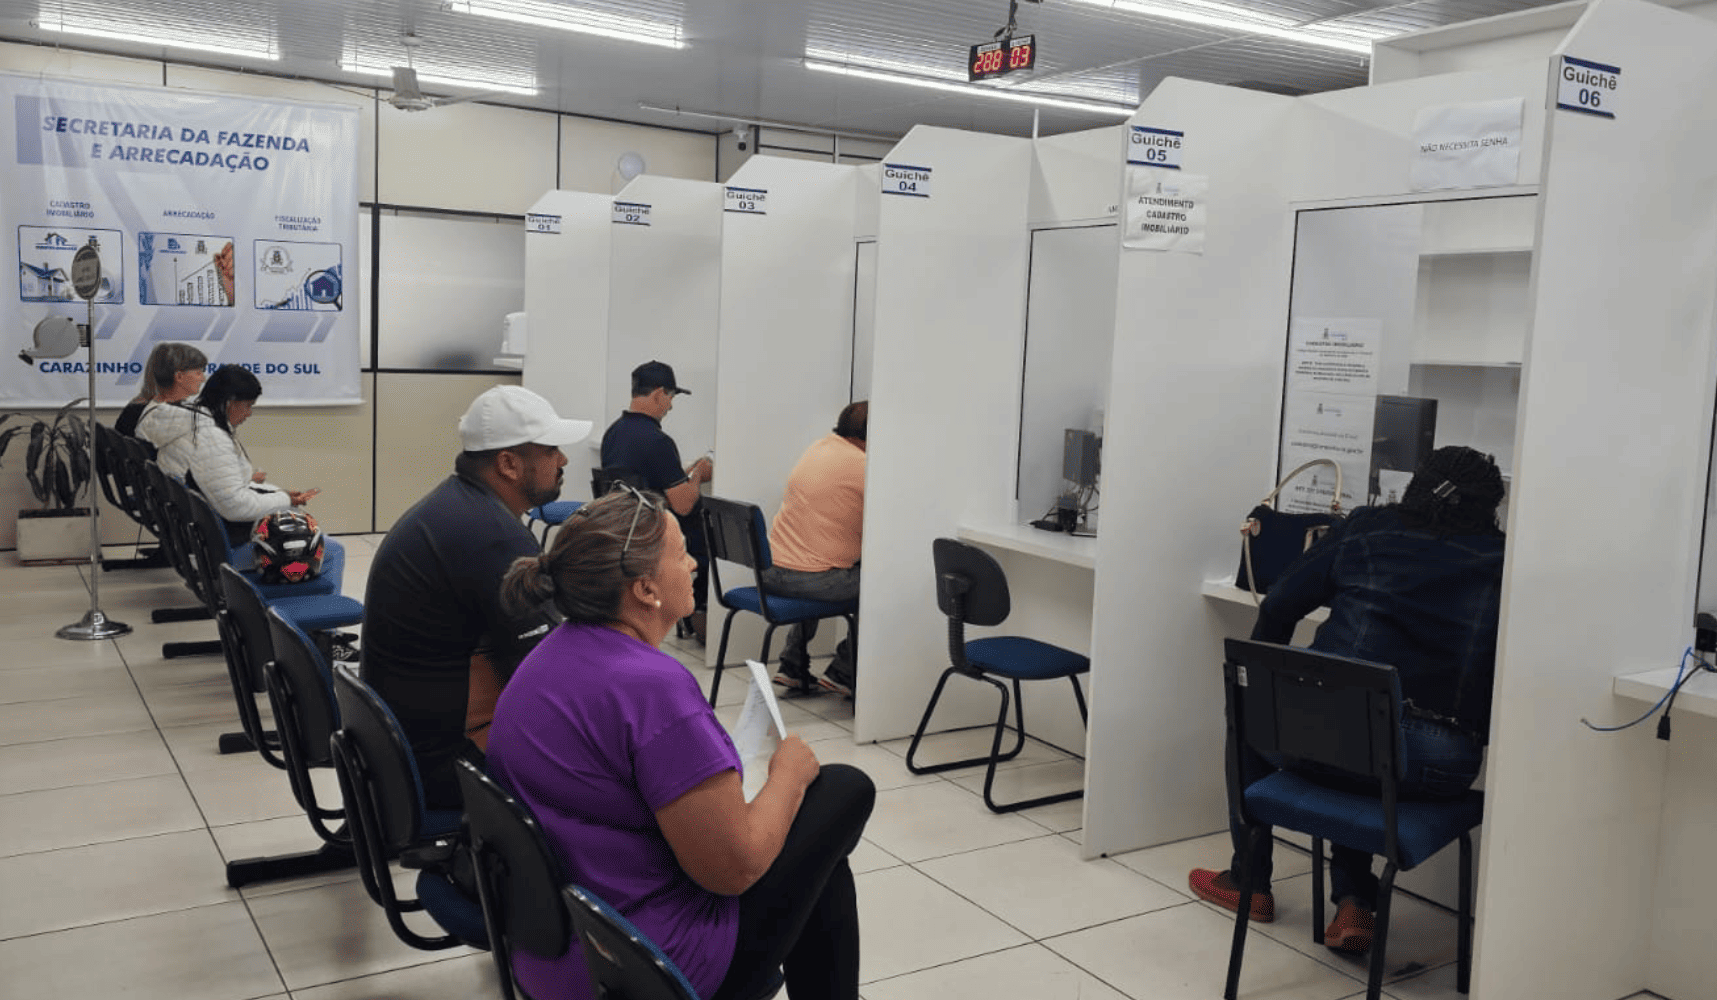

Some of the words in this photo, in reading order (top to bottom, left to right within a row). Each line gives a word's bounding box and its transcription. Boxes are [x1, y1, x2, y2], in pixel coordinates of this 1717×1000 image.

[974, 49, 1003, 74] 288
[1010, 45, 1031, 68] 03
[1563, 65, 1618, 90] Guichê
[1578, 88, 1601, 107] 06
[42, 115, 174, 142] SECRETARIA
[180, 127, 211, 145] DA
[217, 130, 310, 153] FAZENDA
[1131, 132, 1182, 149] Guichê
[1481, 136, 1508, 147] SENHA
[91, 143, 102, 159] E
[109, 144, 270, 173] ARRECADAÇÃO
[1146, 148, 1168, 162] 05
[884, 169, 930, 182] Guichê
[899, 181, 916, 192] 04
[726, 191, 766, 202] Guichê
[1138, 196, 1195, 210] ATENDIMENTO
[738, 200, 755, 211] 03
[625, 213, 641, 223] 02
[1146, 210, 1188, 222] CADASTRO
[265, 363, 288, 375] DO
[293, 363, 321, 375] SUL
